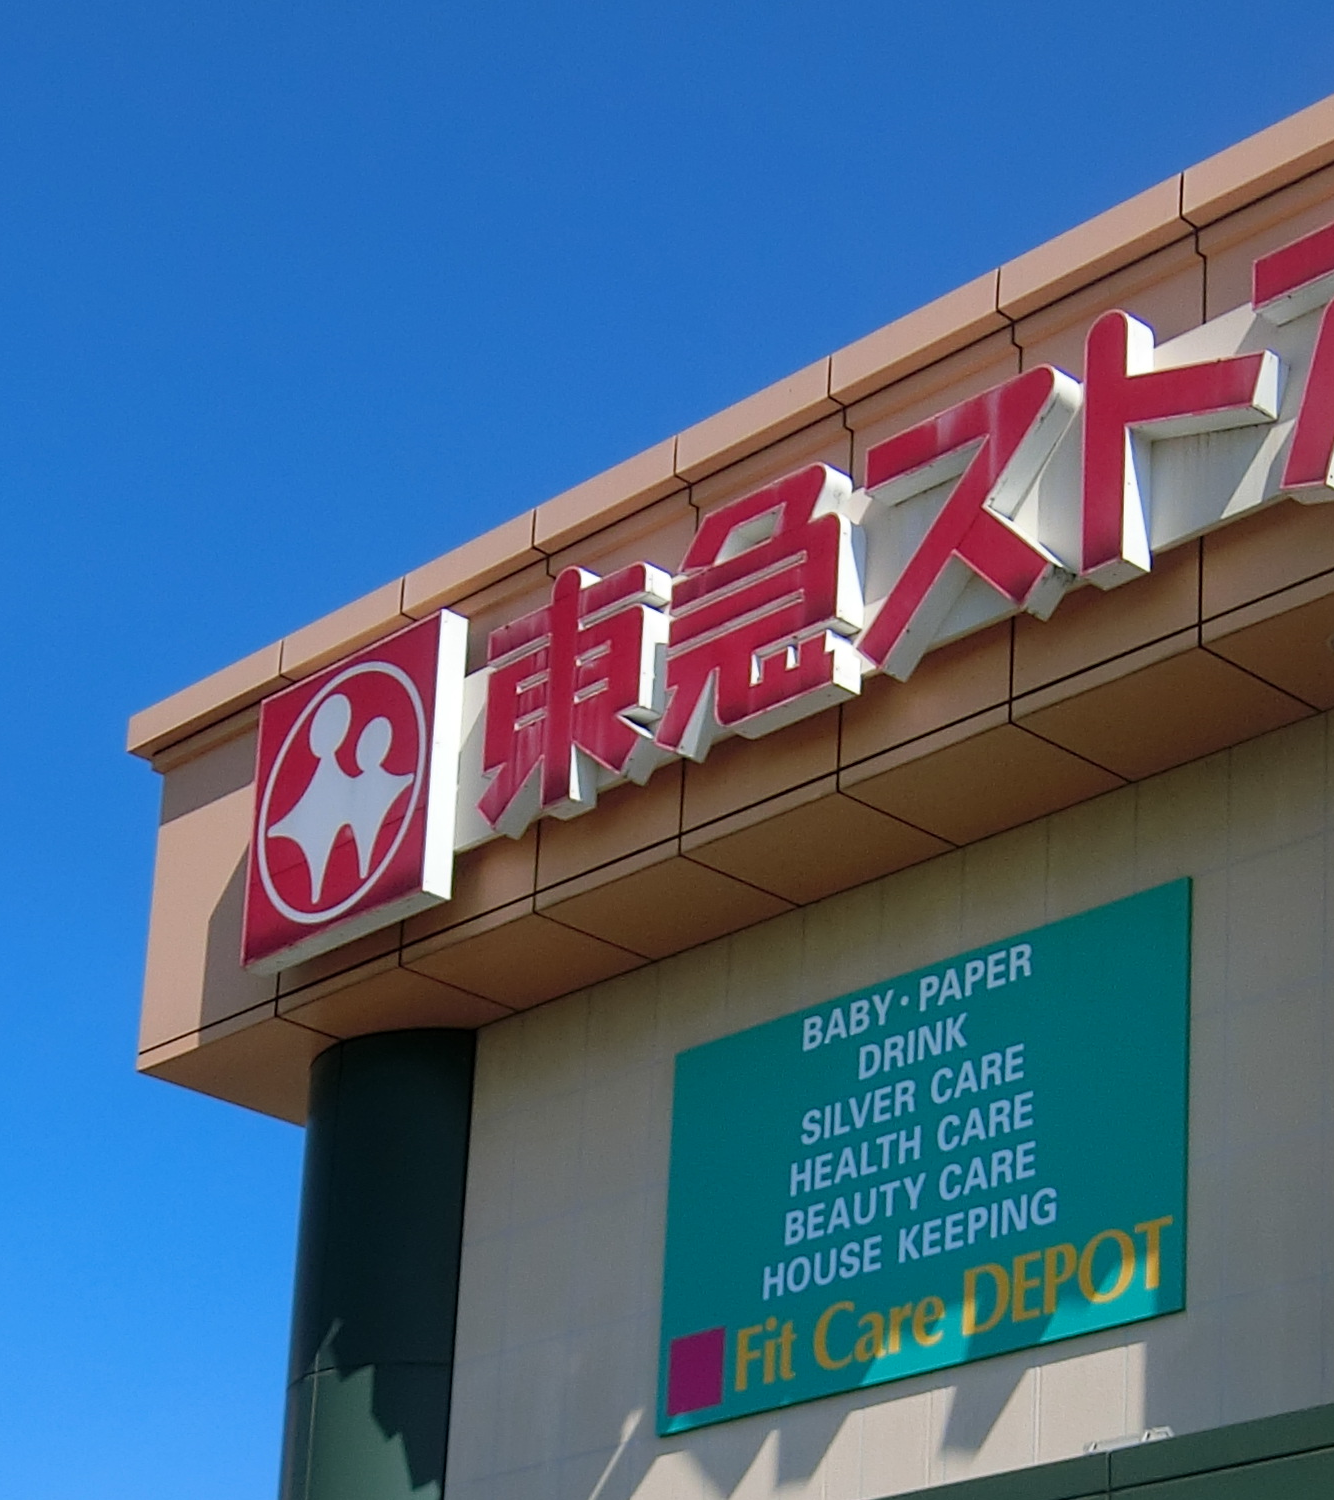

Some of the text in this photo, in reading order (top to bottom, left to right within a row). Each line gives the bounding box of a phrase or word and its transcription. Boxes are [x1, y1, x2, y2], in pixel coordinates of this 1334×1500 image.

[800, 1043, 1025, 1146] SILVER CARE
[857, 1012, 968, 1081] DRINK
[784, 1140, 1036, 1247] BEAUTY CARE
[789, 1090, 1034, 1198] HEALTH CARE
[762, 1186, 1058, 1301] HOUSE KEEPING
[734, 1216, 1173, 1392] Fit Care DEPOT
